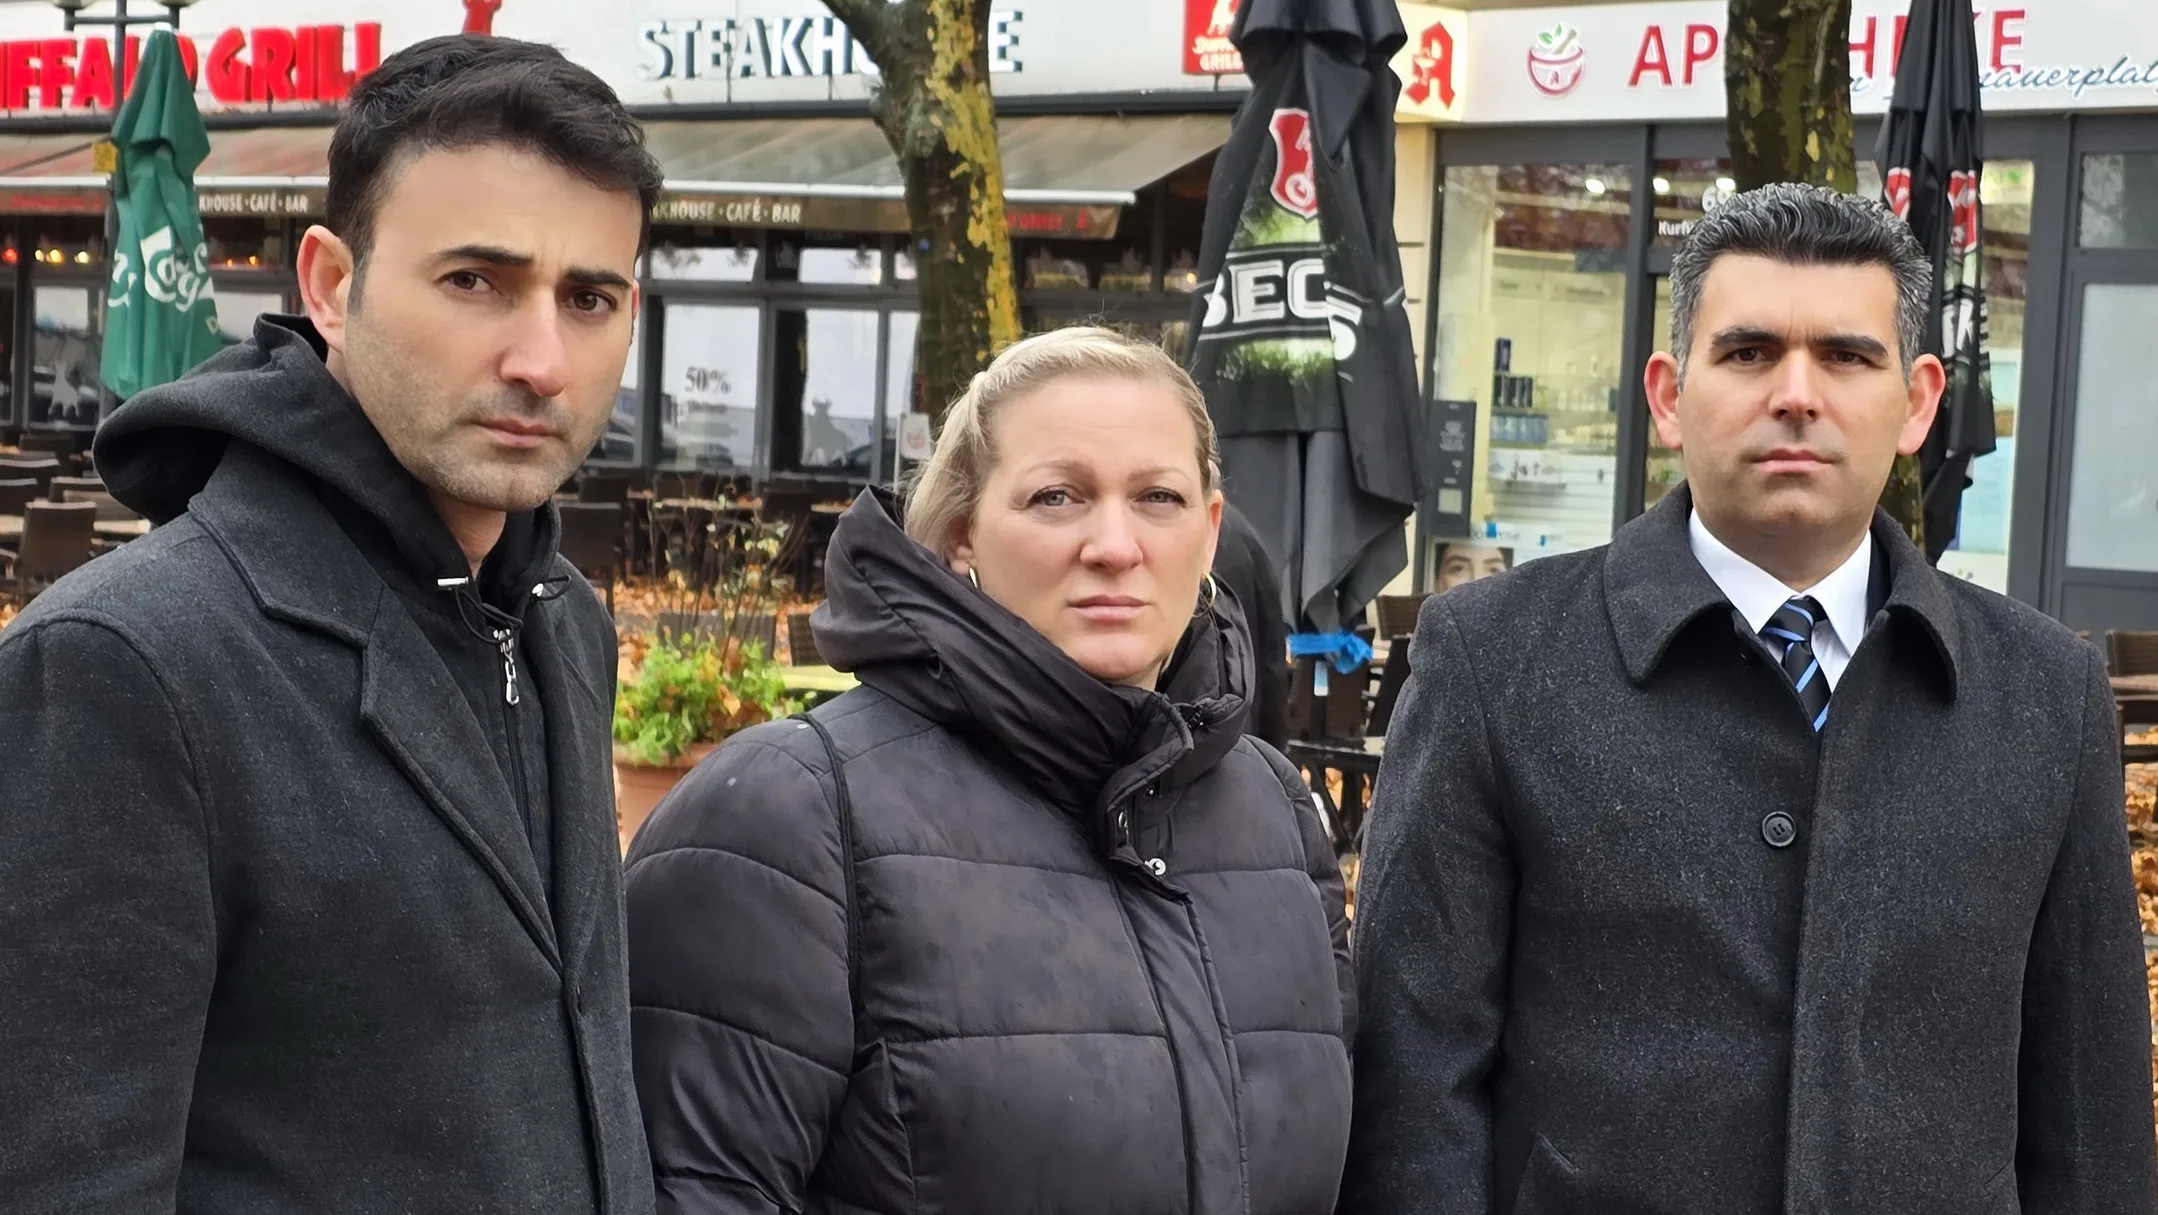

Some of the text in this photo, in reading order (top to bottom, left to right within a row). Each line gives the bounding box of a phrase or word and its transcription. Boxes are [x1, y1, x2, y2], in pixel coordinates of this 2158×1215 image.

[636, 10, 1022, 79] STEAKHE
[1627, 7, 2028, 87] APHE
[726, 197, 761, 222] CAFÉ
[772, 203, 801, 223] BAR
[684, 366, 731, 395] 50%
